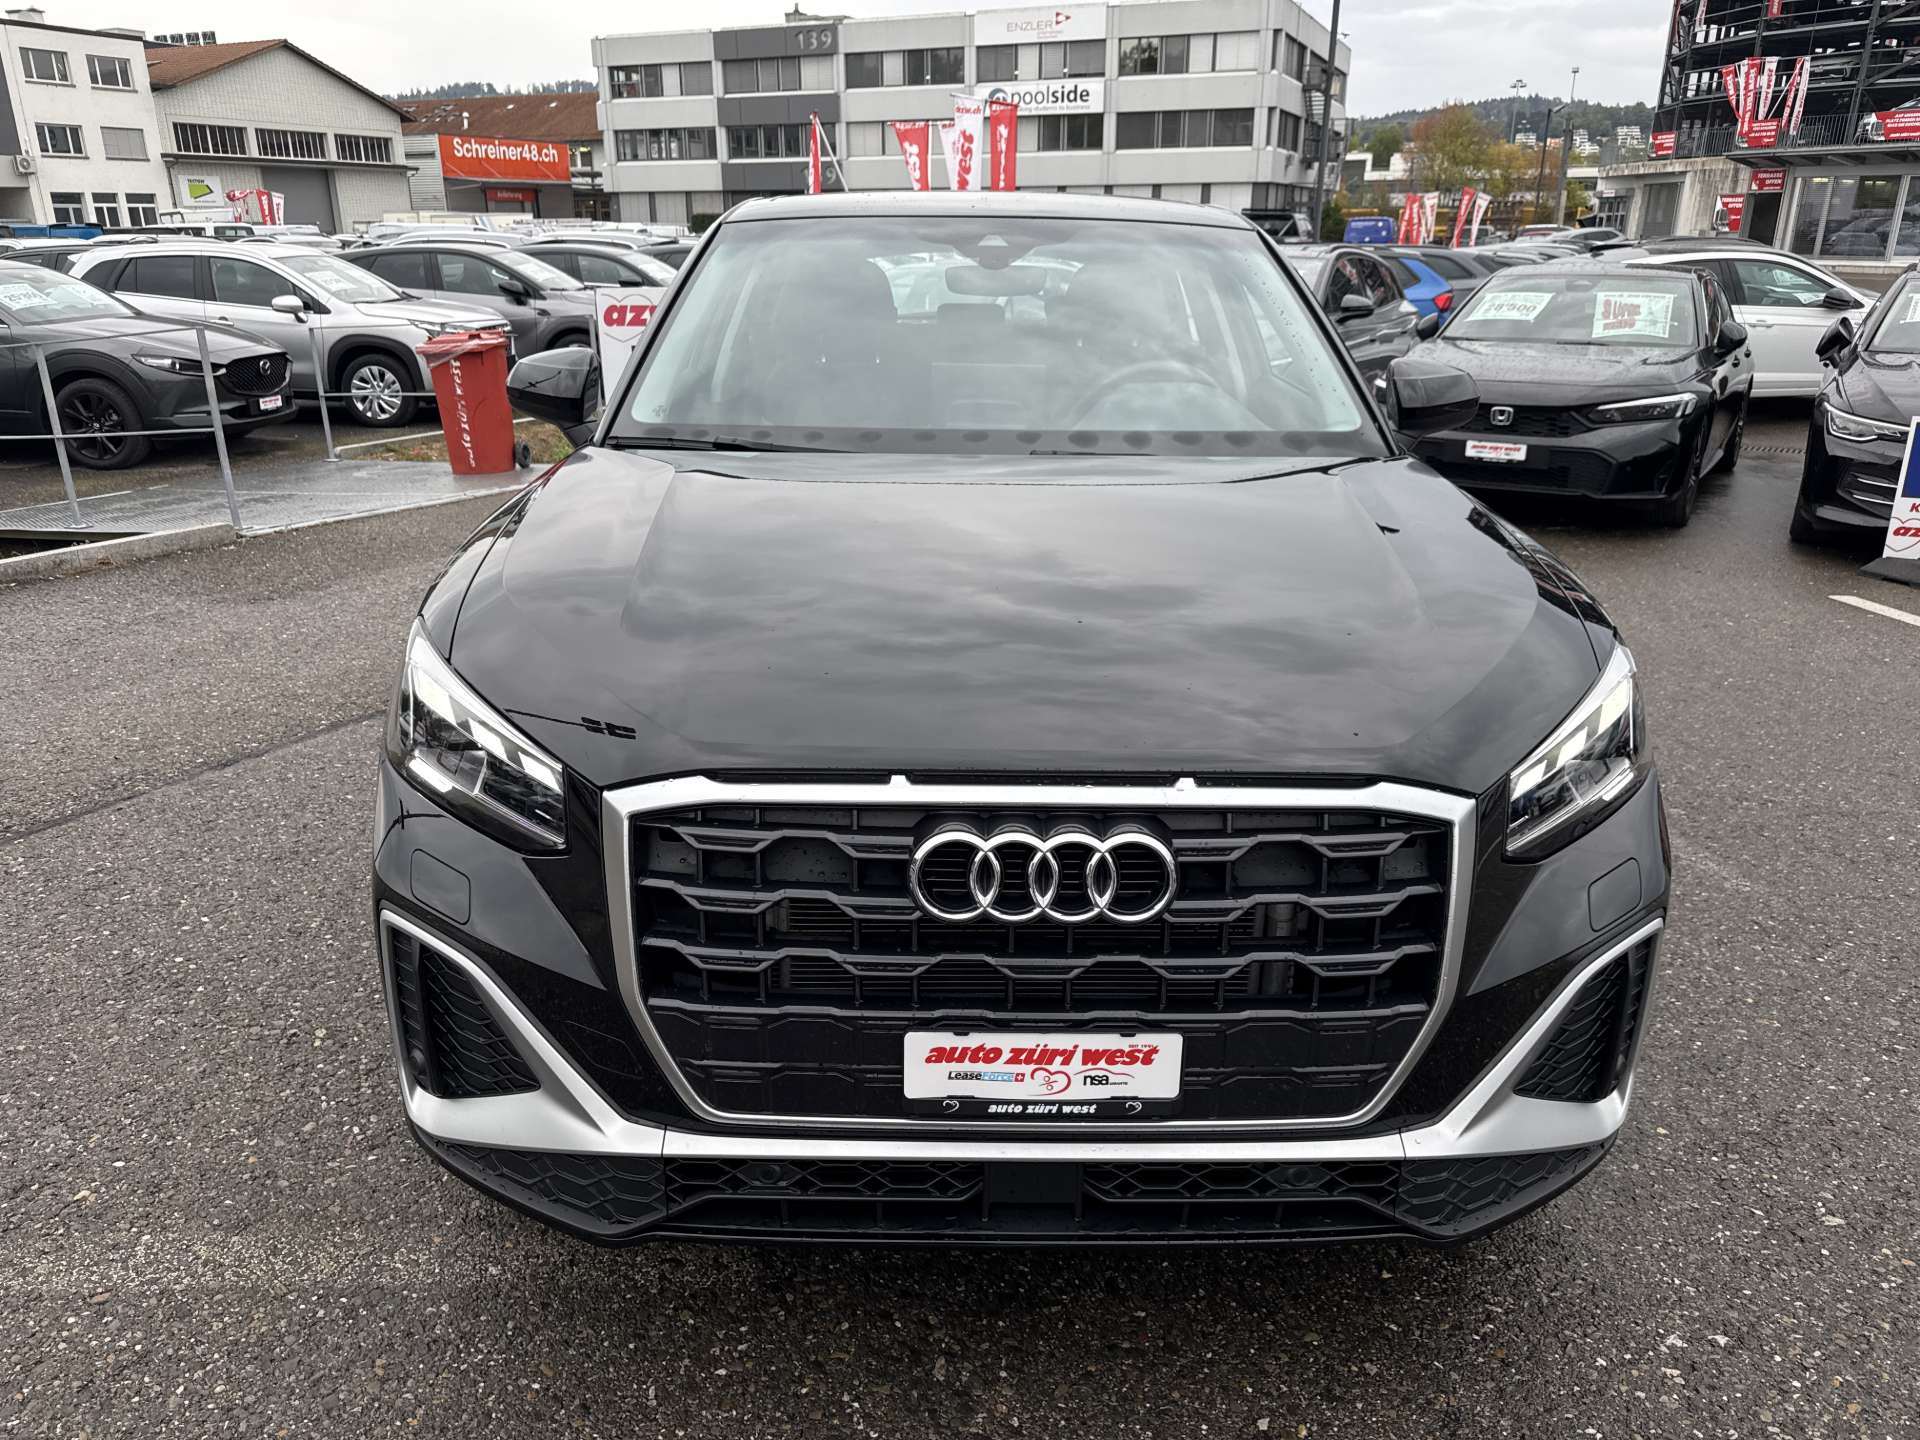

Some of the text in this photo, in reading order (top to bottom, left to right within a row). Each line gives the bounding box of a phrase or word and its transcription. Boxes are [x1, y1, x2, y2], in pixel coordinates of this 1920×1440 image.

[1006, 19, 1053, 32] ENZLER
[796, 30, 832, 50] 139
[1010, 84, 1090, 105] poolside
[453, 137, 559, 163] Schreiner48.ch
[603, 304, 657, 327] az
[925, 1042, 1160, 1066] auto züri west
[1083, 1074, 1109, 1086] nsa
[988, 1102, 1097, 1115] auto züri west
